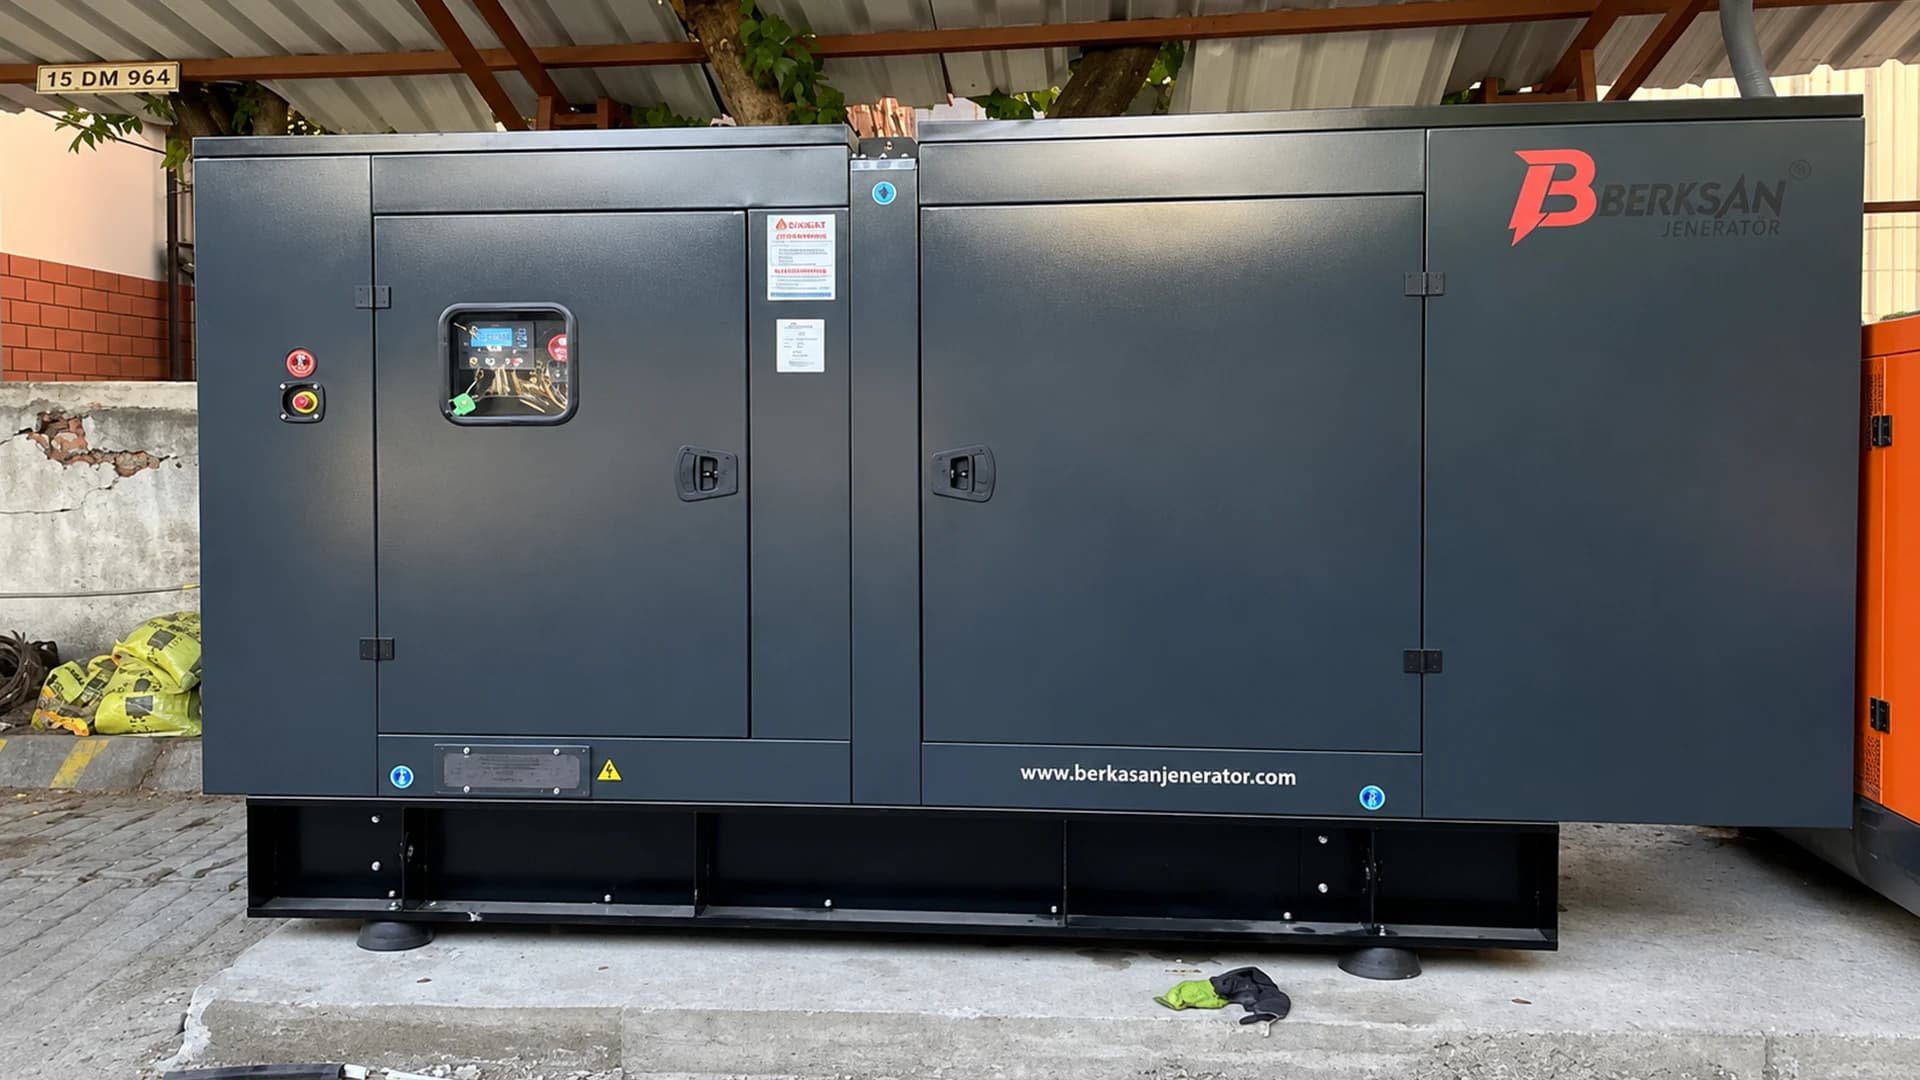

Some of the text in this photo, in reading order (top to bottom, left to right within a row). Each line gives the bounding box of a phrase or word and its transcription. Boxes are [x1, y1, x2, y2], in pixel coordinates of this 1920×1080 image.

[47, 69, 170, 87] 15 DM 964
[1599, 173, 1786, 219] BERKSAN
[1661, 217, 1781, 238] JENERATÖR
[1020, 764, 1297, 787] www.berkasanjenerator.com
